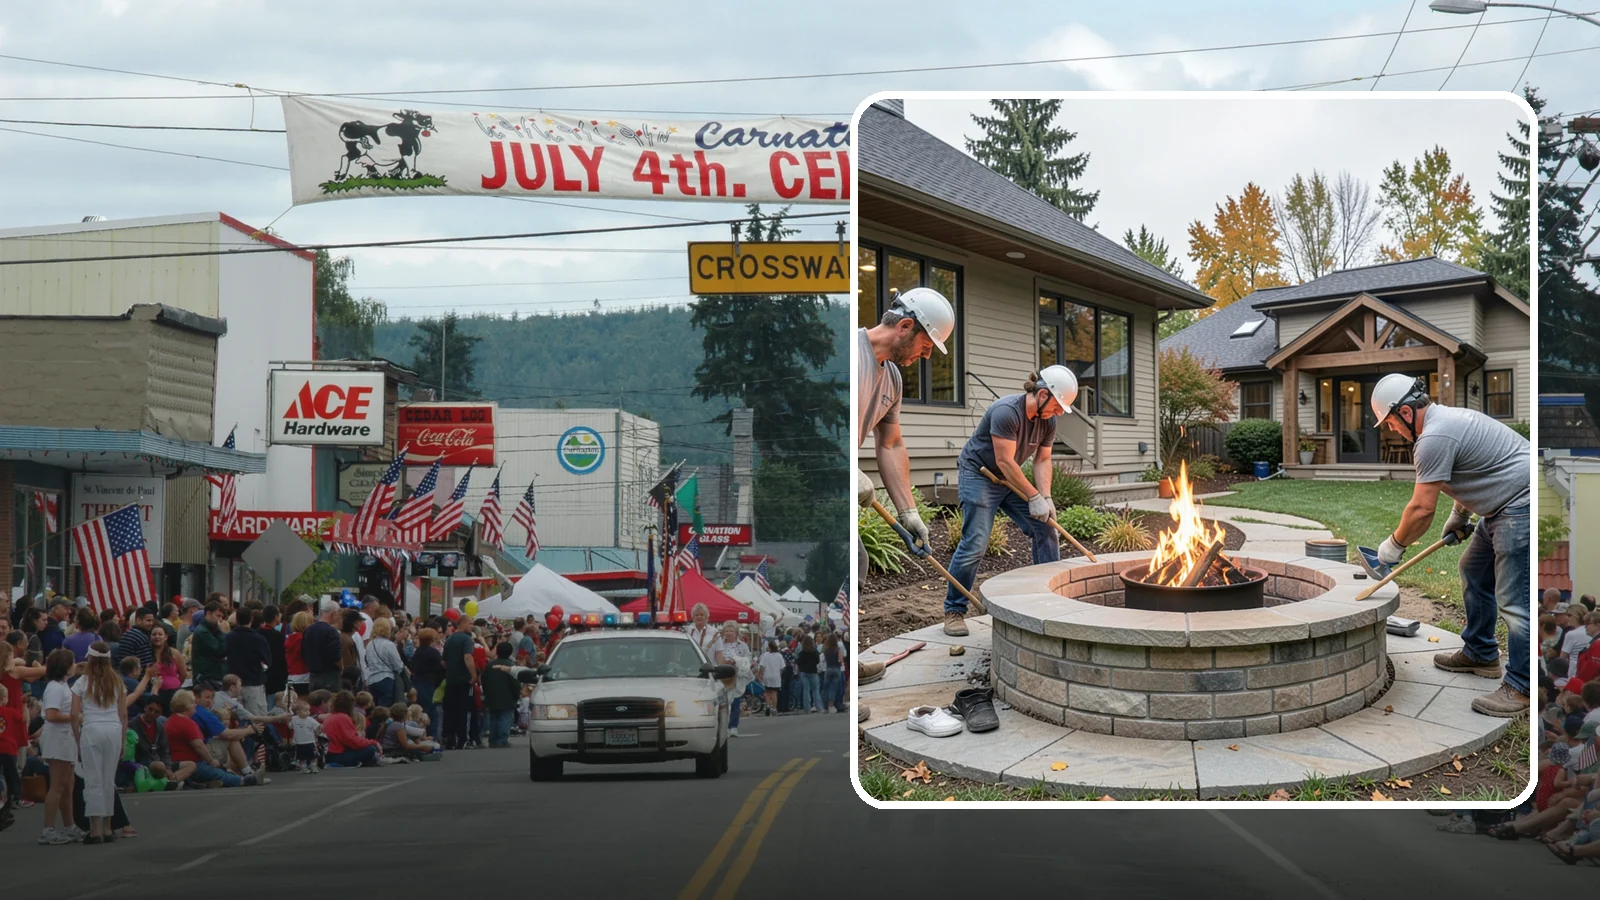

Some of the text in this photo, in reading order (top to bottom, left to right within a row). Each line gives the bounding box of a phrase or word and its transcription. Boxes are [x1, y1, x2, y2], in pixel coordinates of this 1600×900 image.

[695, 121, 850, 149] Carnat
[481, 141, 605, 191] JULY
[632, 150, 746, 198] 4th.
[696, 254, 850, 280] CROSSWA
[282, 380, 374, 420] ACE
[405, 409, 453, 422] CEDAR
[283, 421, 371, 436] Hardware
[416, 428, 477, 447] Coca-Cola
[95, 484, 124, 495] Vincent
[126, 485, 136, 495] de
[138, 485, 155, 496] Paul
[698, 535, 730, 543] GLASS
